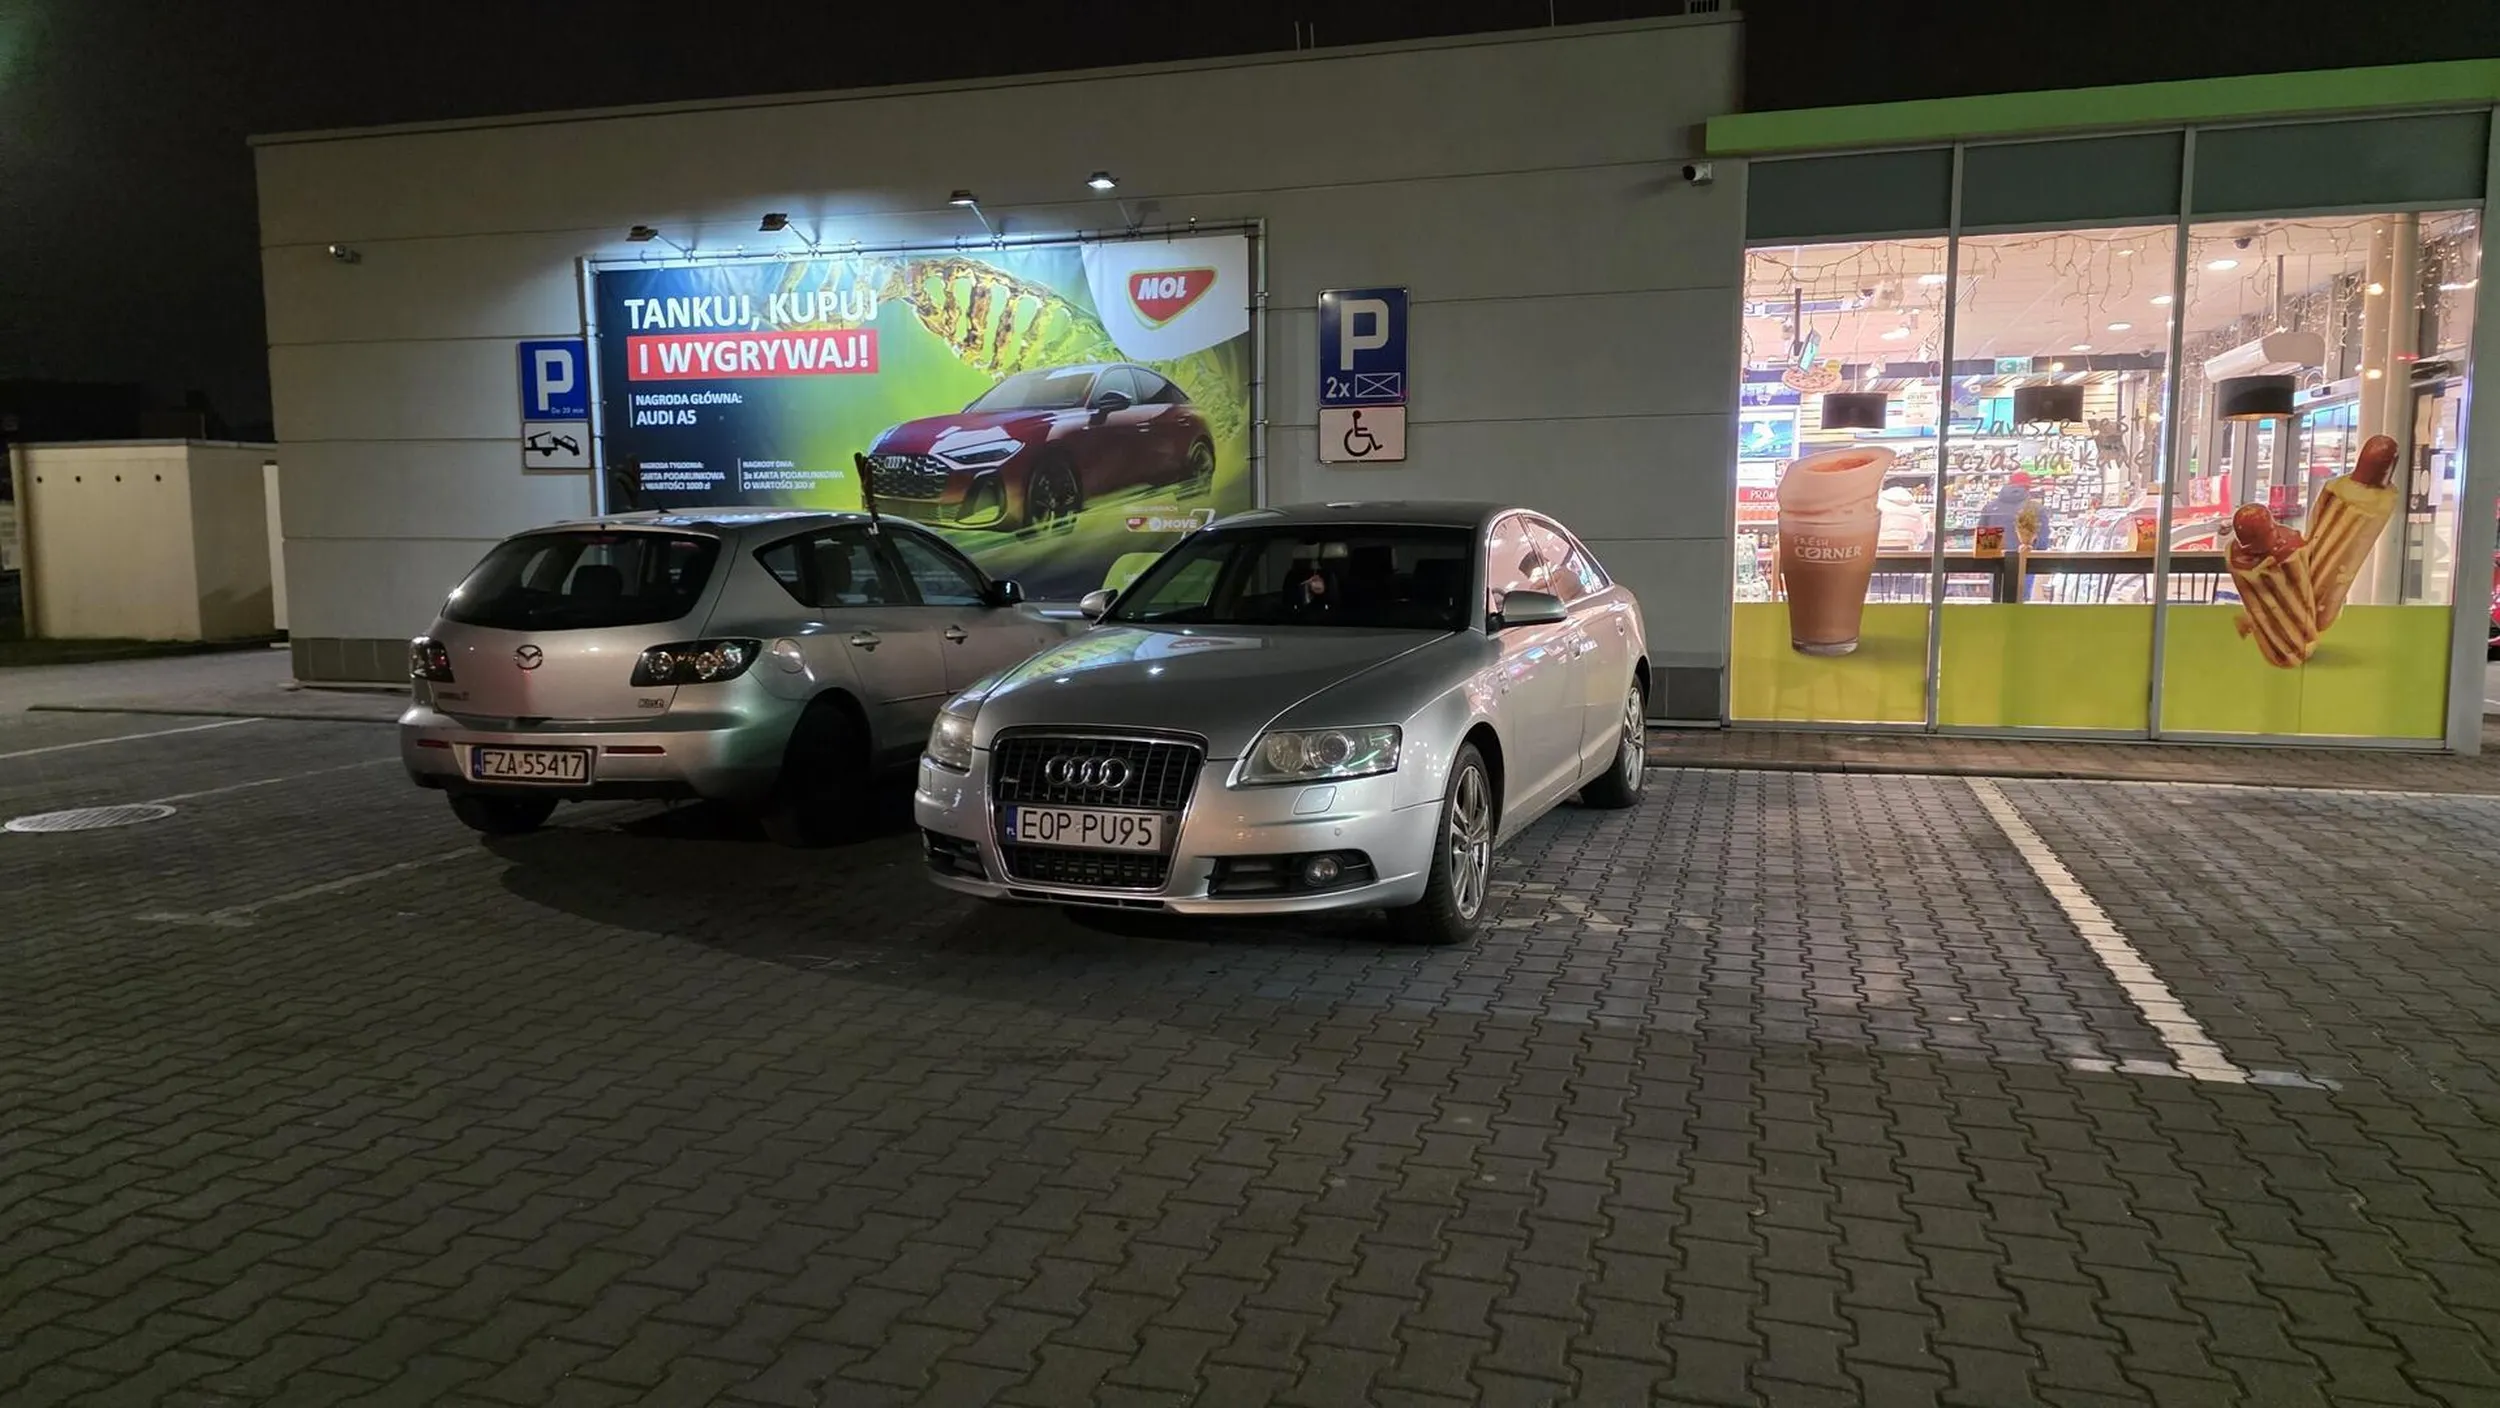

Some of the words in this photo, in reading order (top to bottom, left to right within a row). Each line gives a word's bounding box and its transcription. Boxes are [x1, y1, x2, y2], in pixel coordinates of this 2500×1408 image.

[1137, 276, 1187, 300] MOL
[624, 294, 760, 331] TANKUJ,
[769, 289, 878, 325] KUPUJ
[1340, 298, 1389, 370] P
[639, 344, 649, 375] I
[658, 334, 869, 374] WYGRYWAJ!
[534, 349, 574, 411] P
[1326, 376, 1350, 399] 2x
[635, 393, 689, 406] NAGRODA
[690, 390, 742, 405] GŁÓWNA:
[636, 411, 674, 426] AUDI
[676, 409, 697, 425] A5
[1795, 545, 1863, 560] CORNER
[482, 751, 518, 775] FZA
[523, 752, 583, 778] 55417
[1022, 810, 1071, 841] EOP
[1082, 813, 1153, 847] PU95
